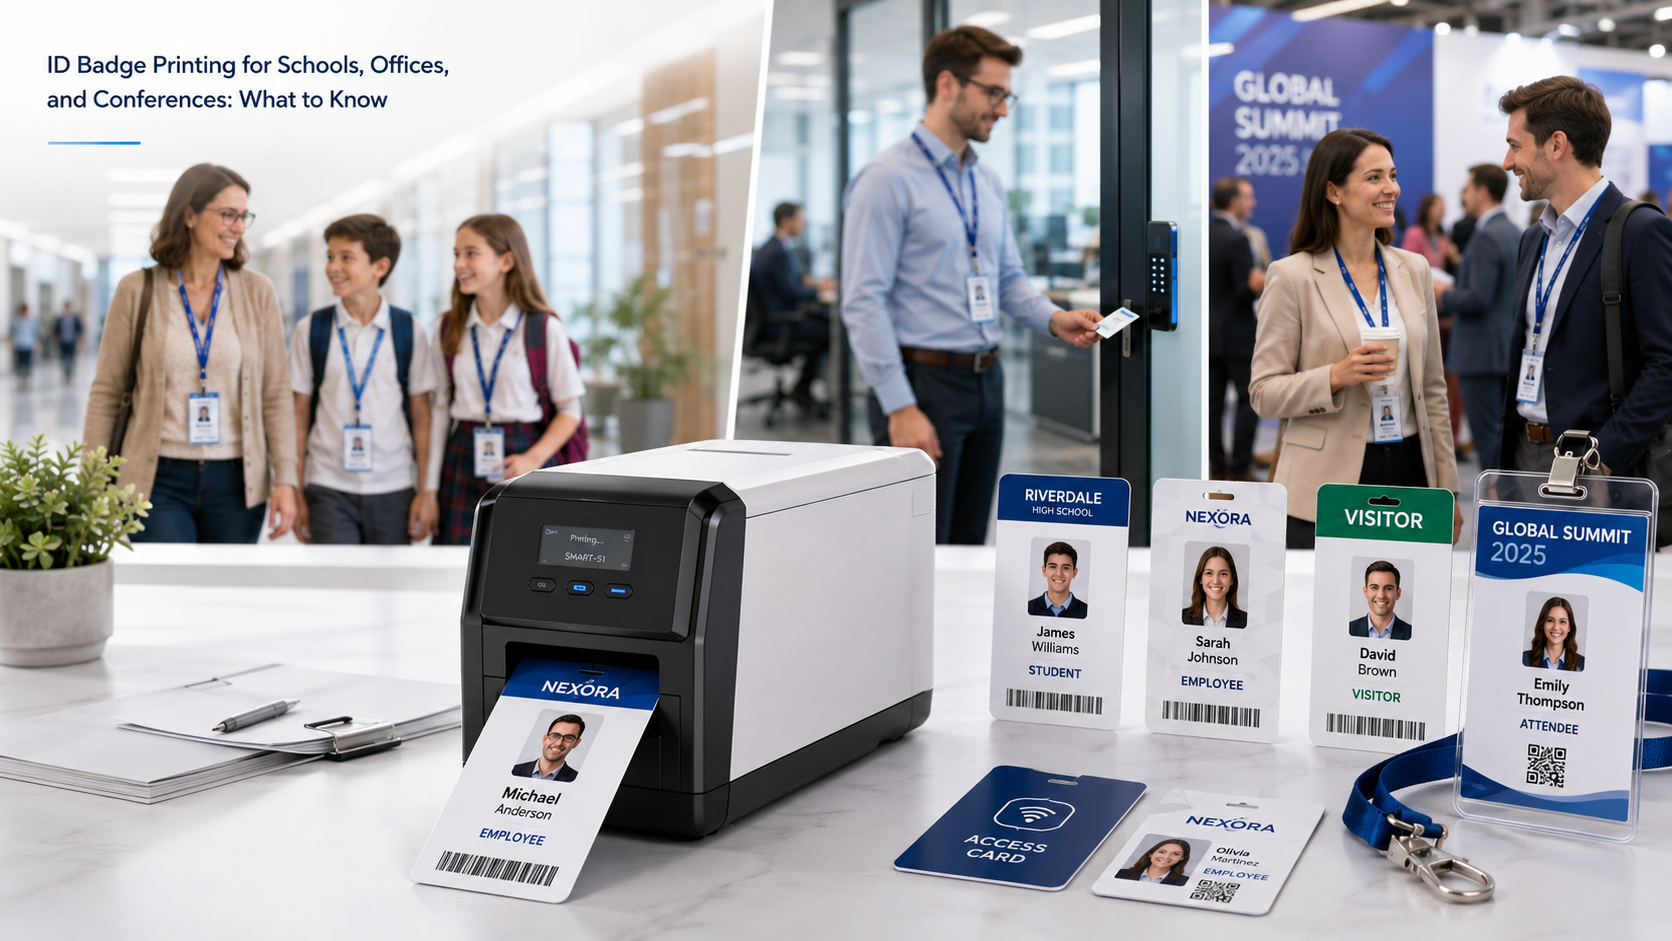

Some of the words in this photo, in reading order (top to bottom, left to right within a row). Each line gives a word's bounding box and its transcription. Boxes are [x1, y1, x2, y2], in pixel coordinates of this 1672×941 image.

[1234, 70, 1341, 107] GLOBAL
[1235, 106, 1343, 141] SUMMIT
[1235, 143, 1300, 177] 2025
[1025, 488, 1102, 505] RIVERDALE
[1032, 506, 1054, 516] HIGH
[1056, 507, 1093, 518] SCHOOL
[1344, 509, 1424, 529] VISITOR
[1492, 520, 1559, 540] GLOBAL
[1563, 526, 1632, 545] SUMMIT
[1490, 541, 1547, 565] 2025
[1036, 626, 1075, 640] James
[1032, 641, 1080, 656] Williams
[1195, 636, 1231, 650] Sarah
[1187, 651, 1239, 666] Johnson
[1359, 648, 1396, 662] David
[1028, 665, 1082, 679] STUDENT
[1358, 663, 1397, 678] Brown
[1181, 675, 1244, 691] EMPLOYEE
[1534, 678, 1570, 694] Emily
[1352, 688, 1401, 703] VISITOR
[1517, 692, 1585, 711] Thompson
[1520, 718, 1579, 735] ATTENDEE
[501, 786, 562, 805] Michael
[494, 803, 552, 820] Anderson
[479, 827, 546, 846] EMPLOYEE
[963, 834, 1048, 854] ACCESS
[966, 848, 1026, 865] CARD
[1216, 847, 1250, 857] Olivia
[1211, 855, 1259, 867] Martinez
[1203, 867, 1269, 881] EMPLOYEE
